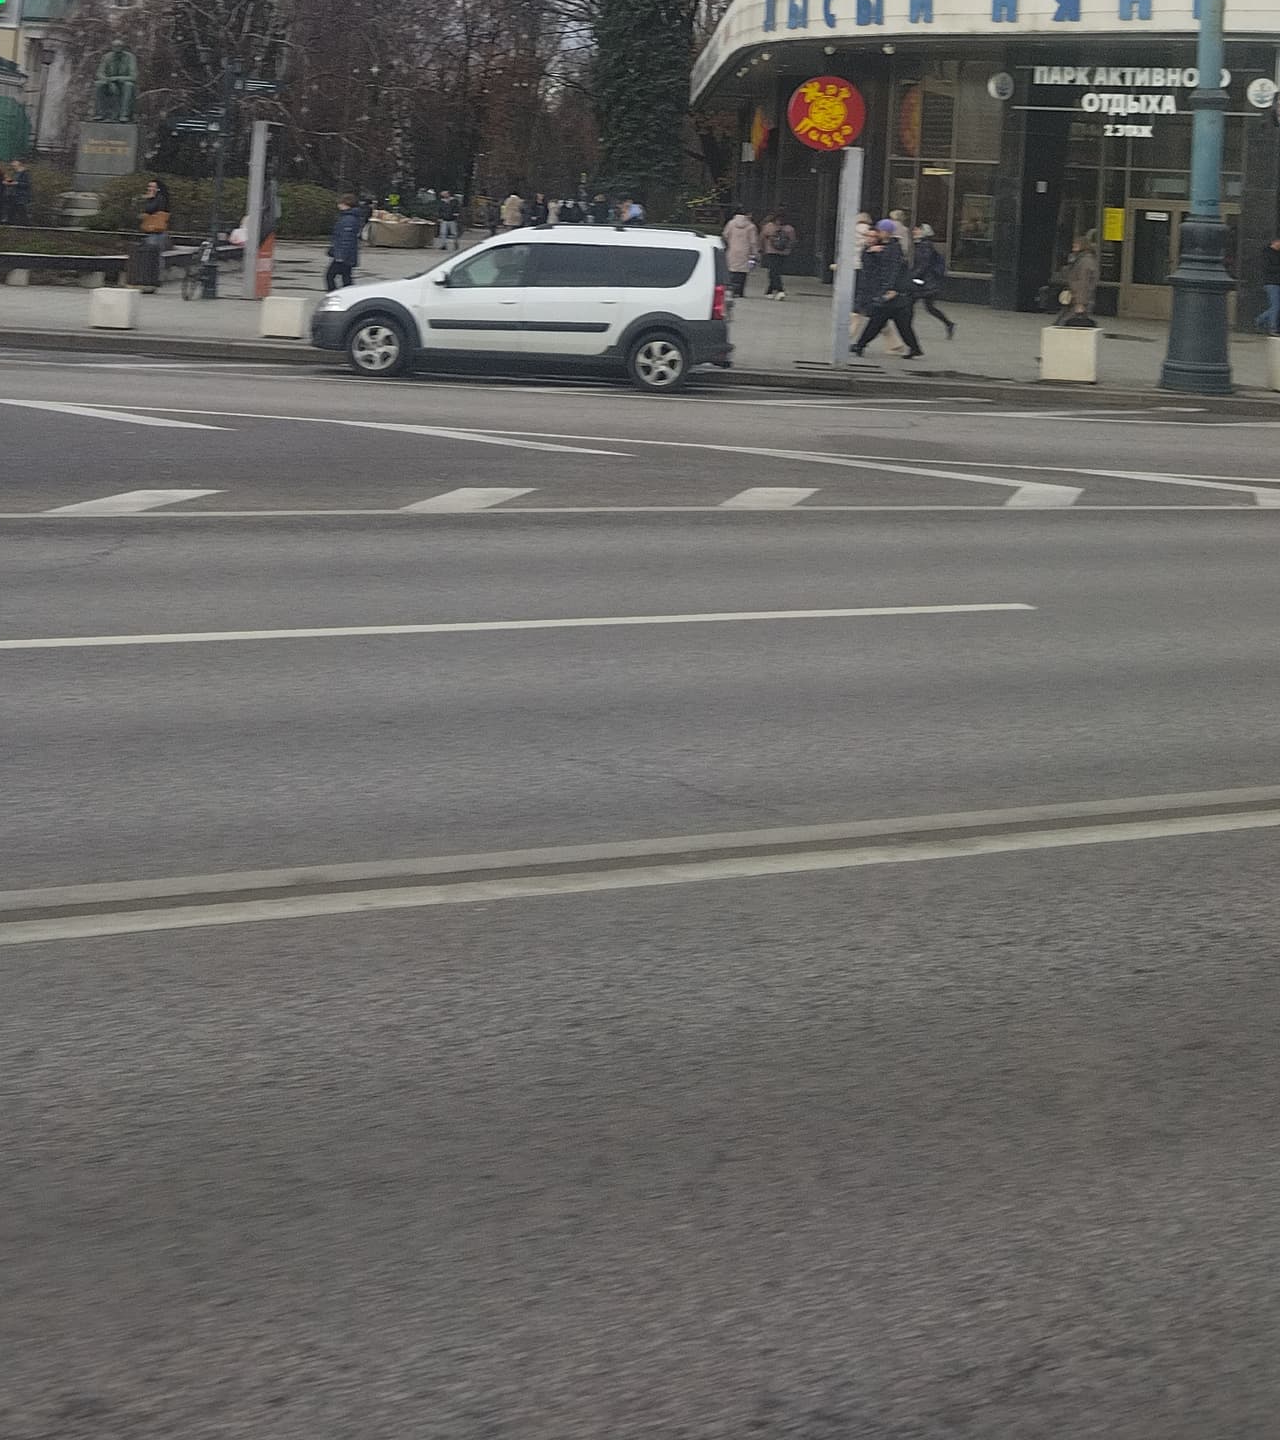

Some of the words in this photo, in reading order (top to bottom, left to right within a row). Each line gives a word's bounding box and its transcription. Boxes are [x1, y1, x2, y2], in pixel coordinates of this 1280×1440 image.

[1033, 66, 1089, 86] ПАРК
[1093, 66, 1232, 88] АКТИВНОО
[1080, 92, 1177, 117] ОТДЫХА
